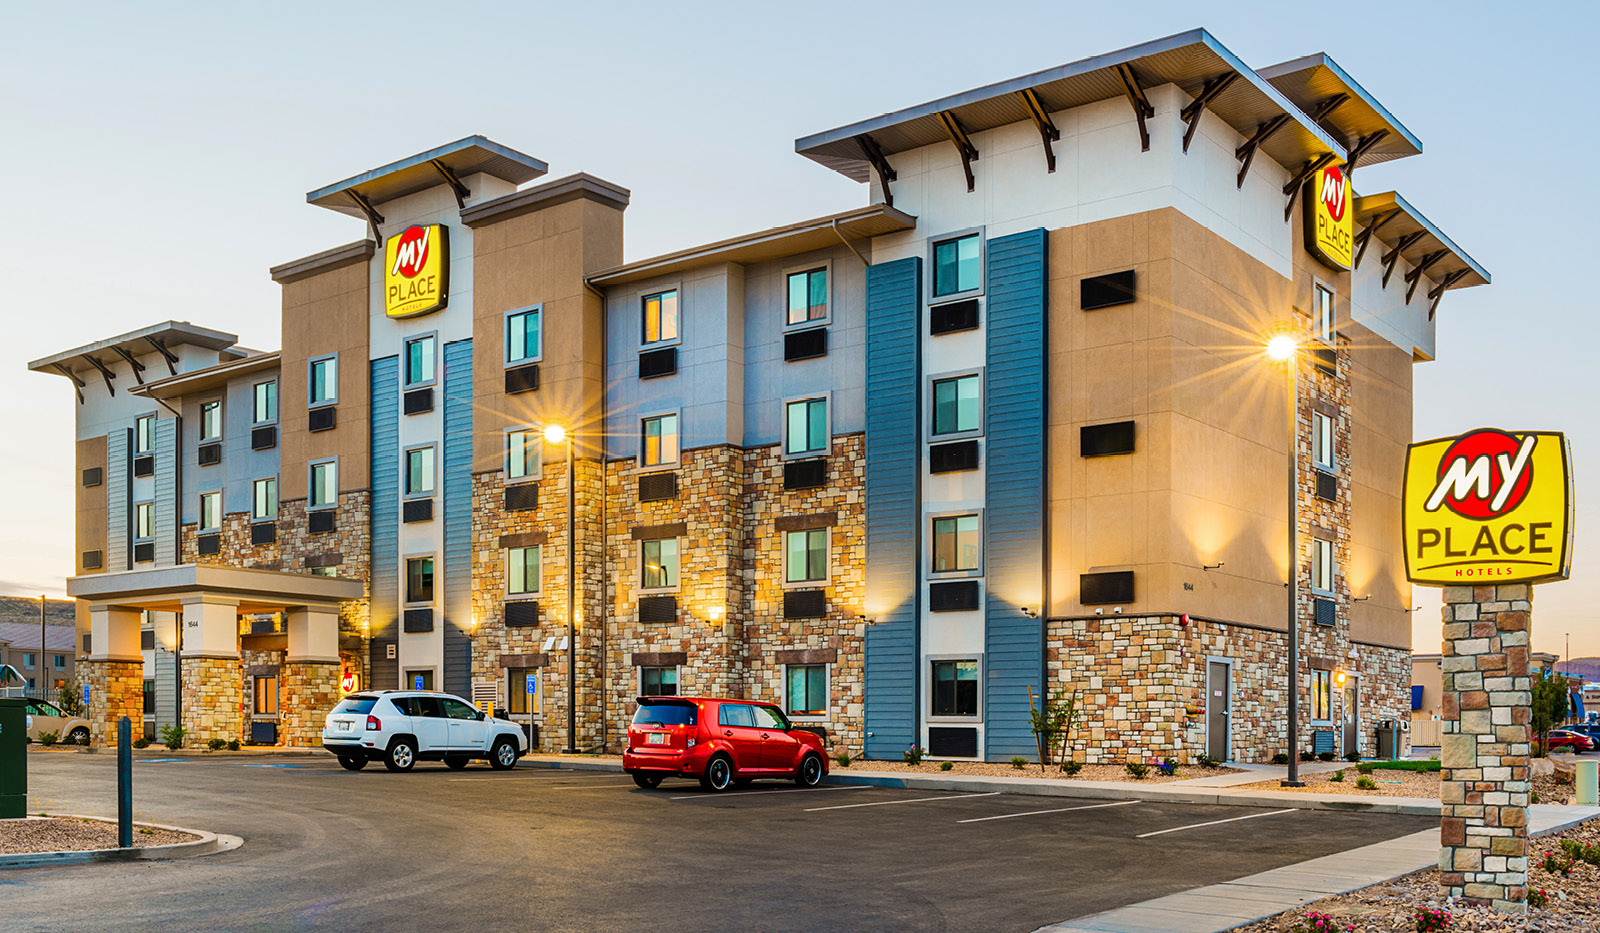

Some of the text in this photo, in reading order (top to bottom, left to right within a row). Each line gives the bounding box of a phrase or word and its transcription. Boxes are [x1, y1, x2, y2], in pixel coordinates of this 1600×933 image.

[1319, 212, 1350, 255] PLACE
[389, 275, 436, 304] PLACE
[1416, 521, 1553, 559] PLACE
[1455, 567, 1512, 577] HOTELS
